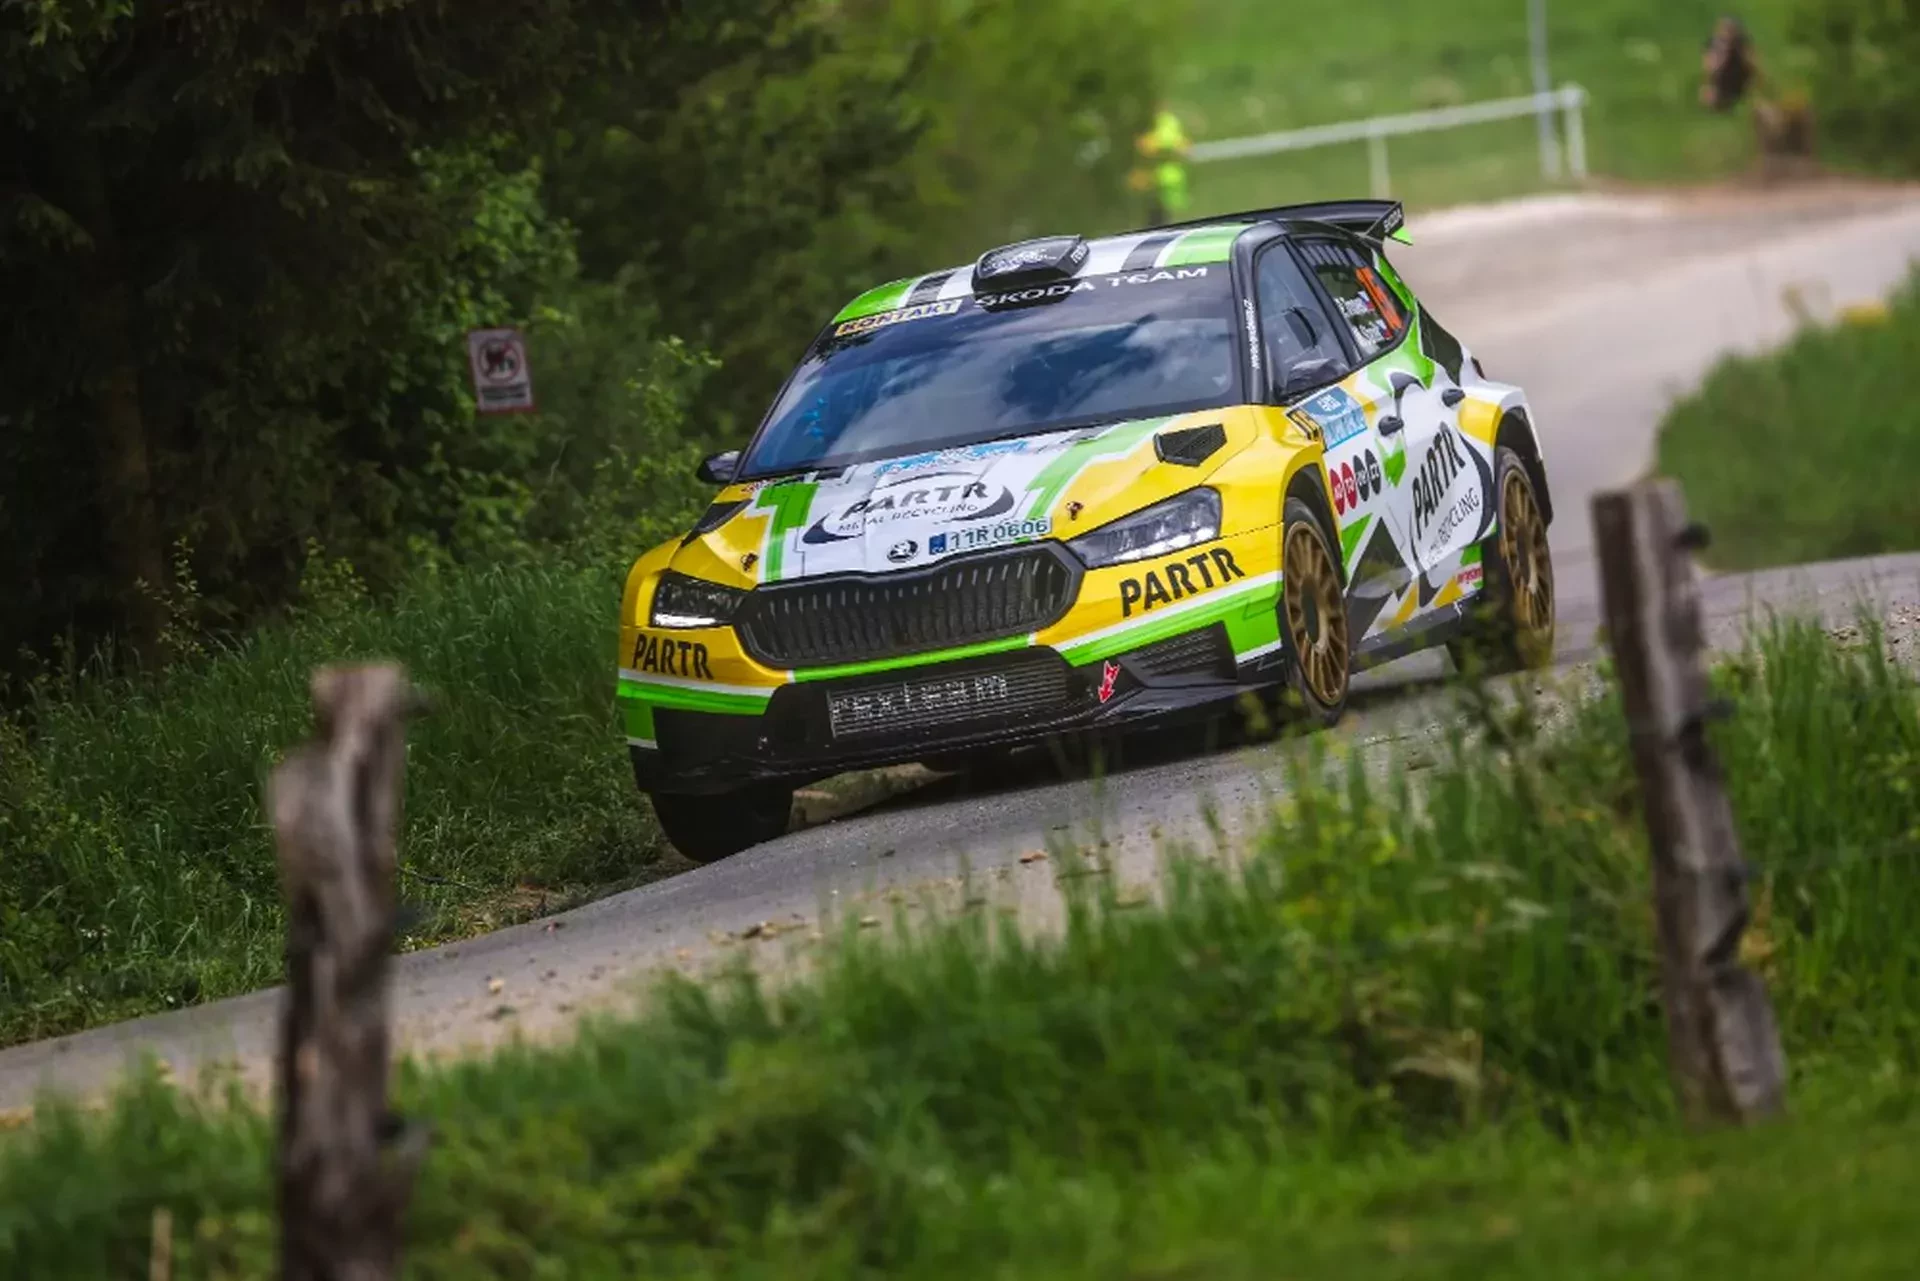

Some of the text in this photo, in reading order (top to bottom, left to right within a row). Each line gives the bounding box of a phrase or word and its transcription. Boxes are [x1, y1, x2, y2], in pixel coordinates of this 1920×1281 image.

[1105, 266, 1208, 287] TEAM
[1412, 421, 1466, 541] PARTR
[839, 482, 989, 521] PARTR
[891, 502, 978, 521] RECYCLING
[993, 519, 1049, 539] 0606
[1120, 547, 1246, 618] PARTR
[632, 633, 714, 681] PARTR
